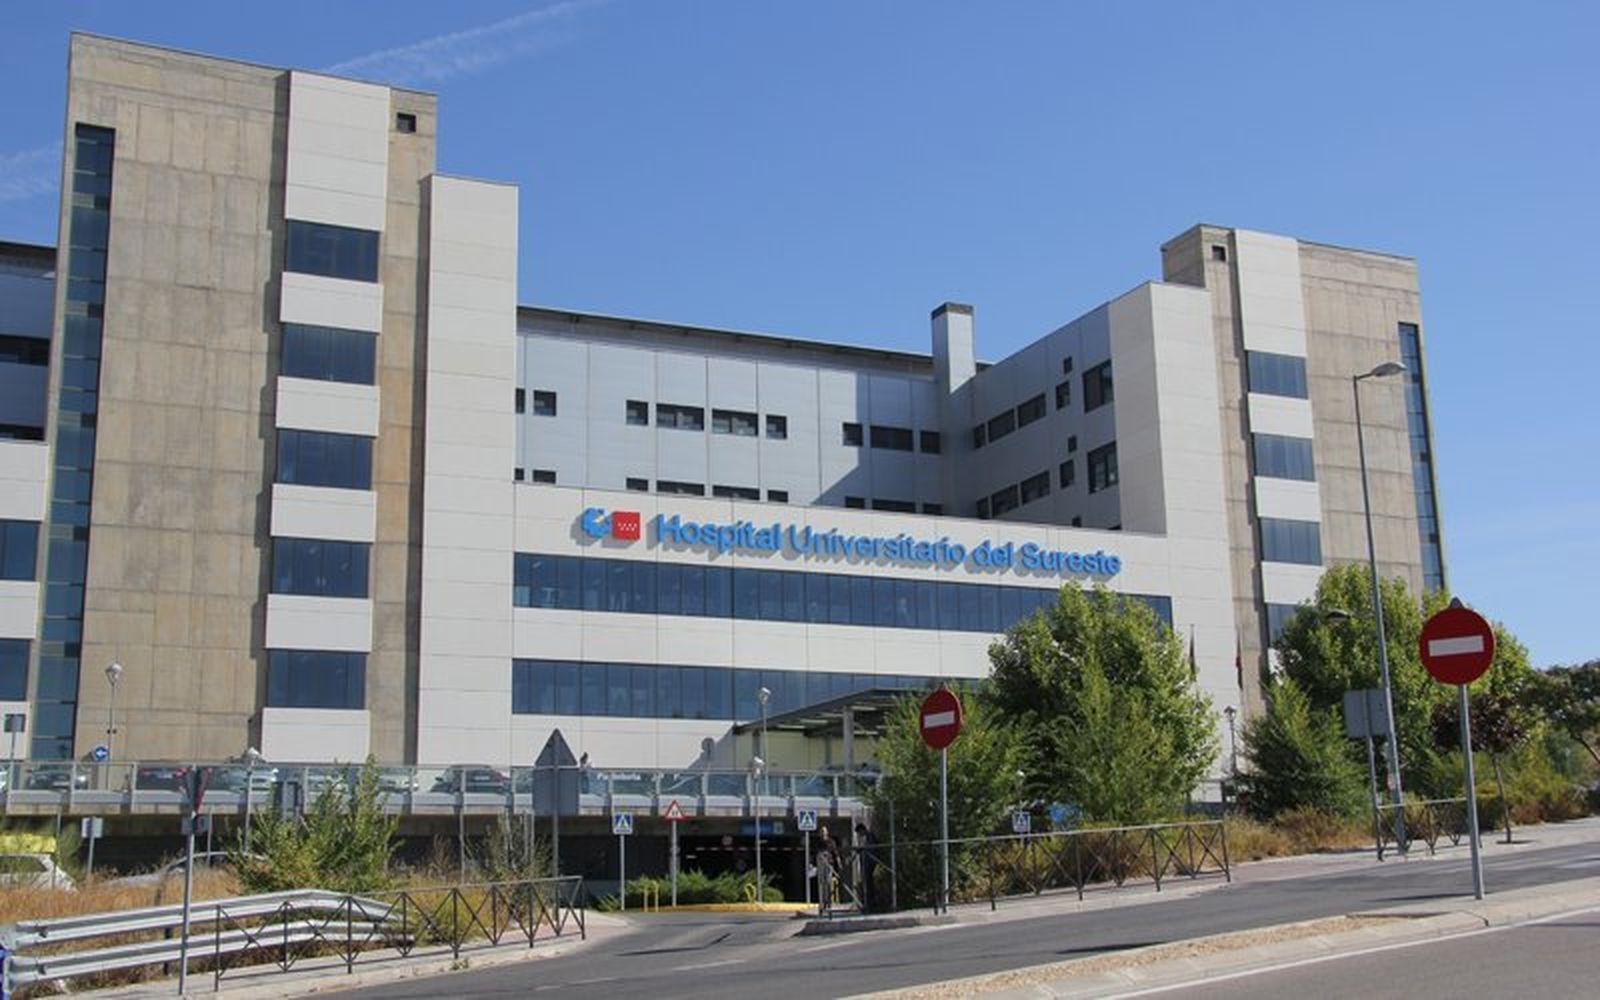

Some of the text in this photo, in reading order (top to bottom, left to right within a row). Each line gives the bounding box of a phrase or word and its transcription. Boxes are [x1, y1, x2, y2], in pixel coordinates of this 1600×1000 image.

[655, 513, 1120, 575] Hospital Universitario del Sureste
